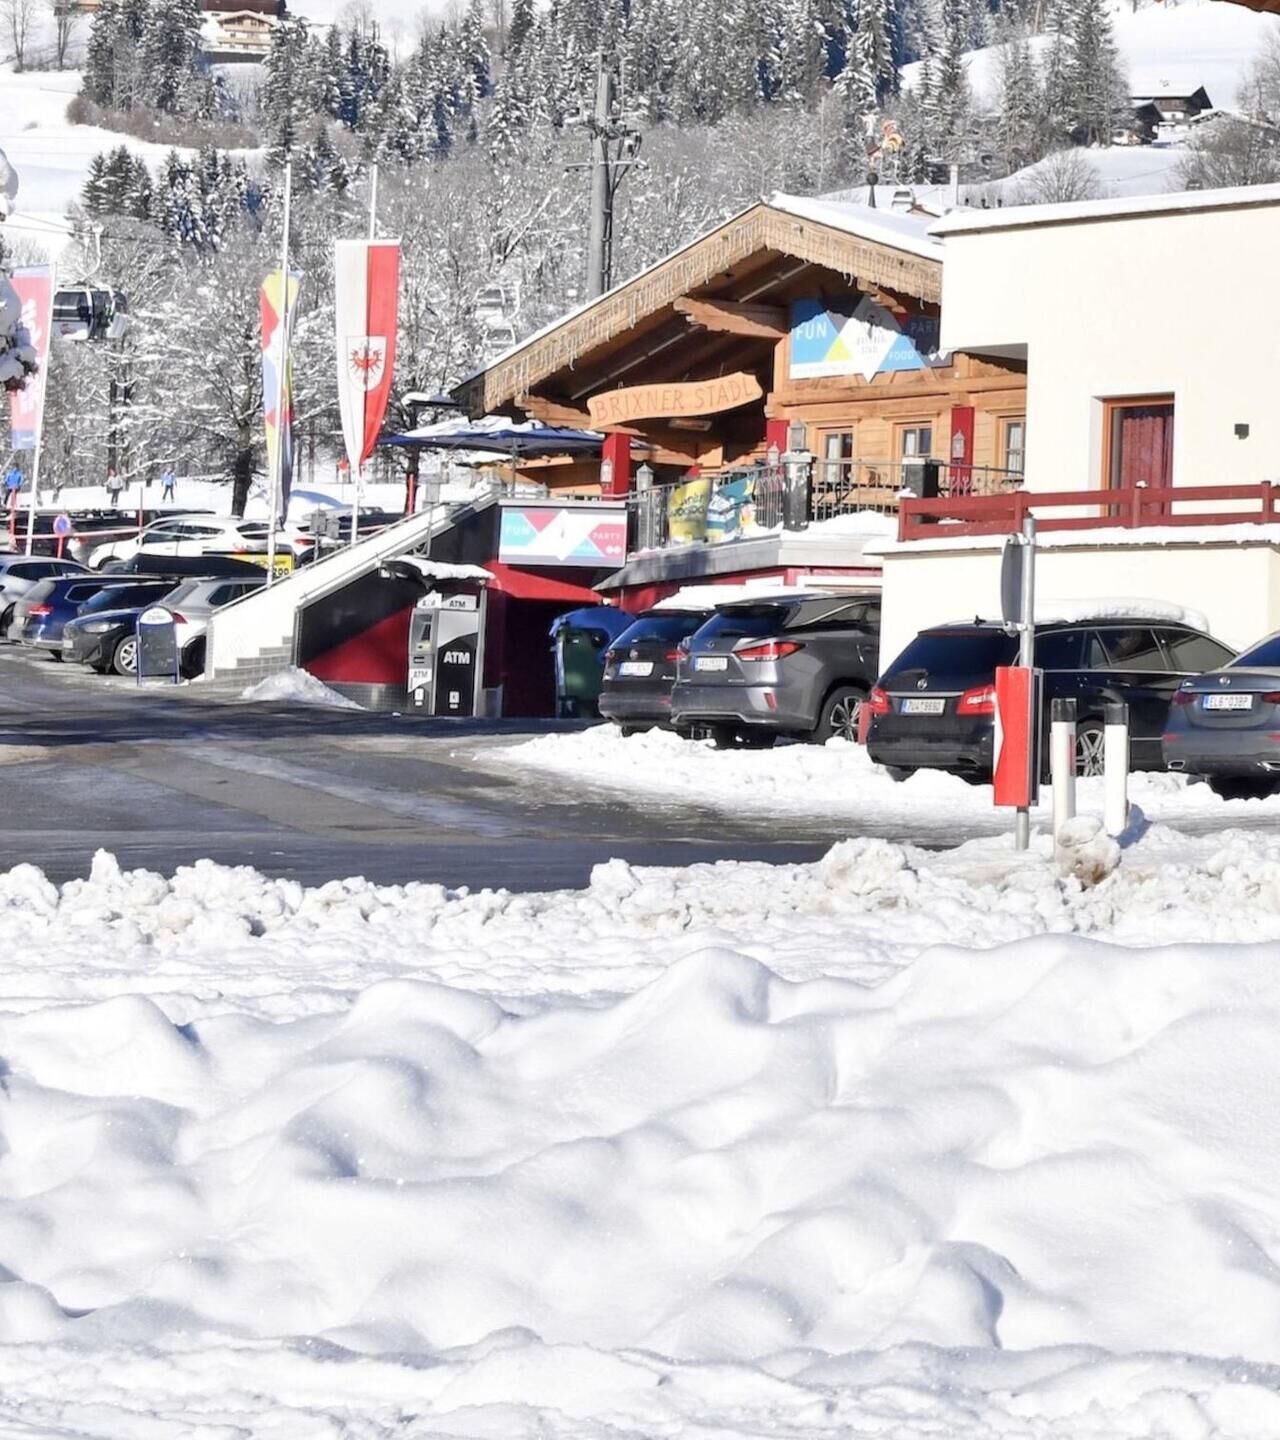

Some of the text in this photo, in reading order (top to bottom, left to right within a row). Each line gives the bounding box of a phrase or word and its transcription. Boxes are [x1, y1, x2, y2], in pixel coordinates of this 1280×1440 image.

[796, 322, 827, 340] FUN
[889, 352, 914, 360] FOOD
[594, 377, 753, 422] BRIXNER STADL
[592, 532, 621, 540] PARTY
[449, 600, 466, 608] ATM
[443, 651, 470, 665] ATM
[413, 670, 428, 678] ATM
